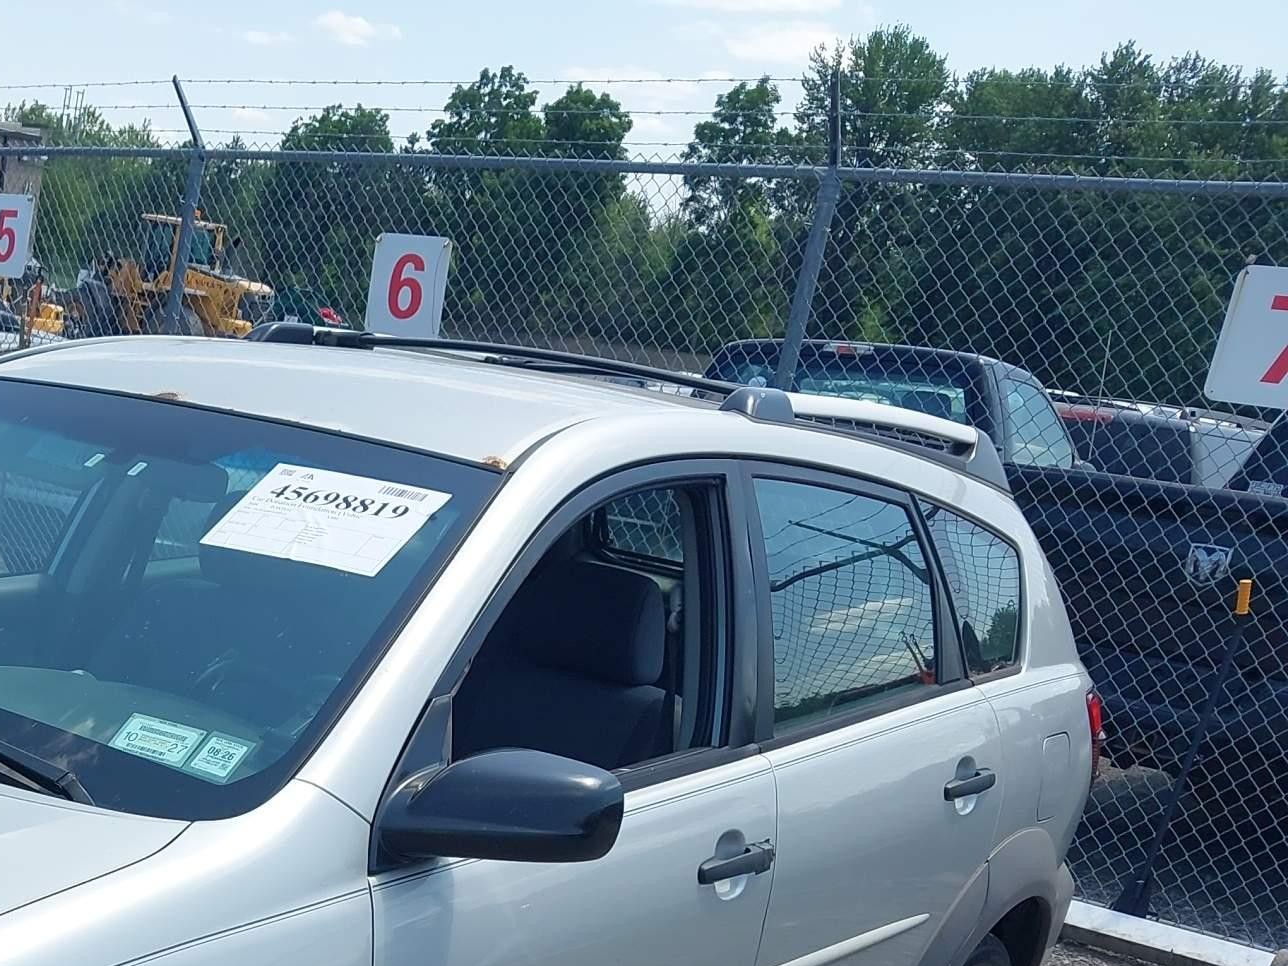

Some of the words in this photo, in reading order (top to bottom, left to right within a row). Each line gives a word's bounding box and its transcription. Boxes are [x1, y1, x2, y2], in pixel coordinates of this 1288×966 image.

[387, 252, 426, 320] 6
[269, 483, 410, 519] 45698819
[123, 731, 139, 743] 10
[167, 743, 189, 755] 27
